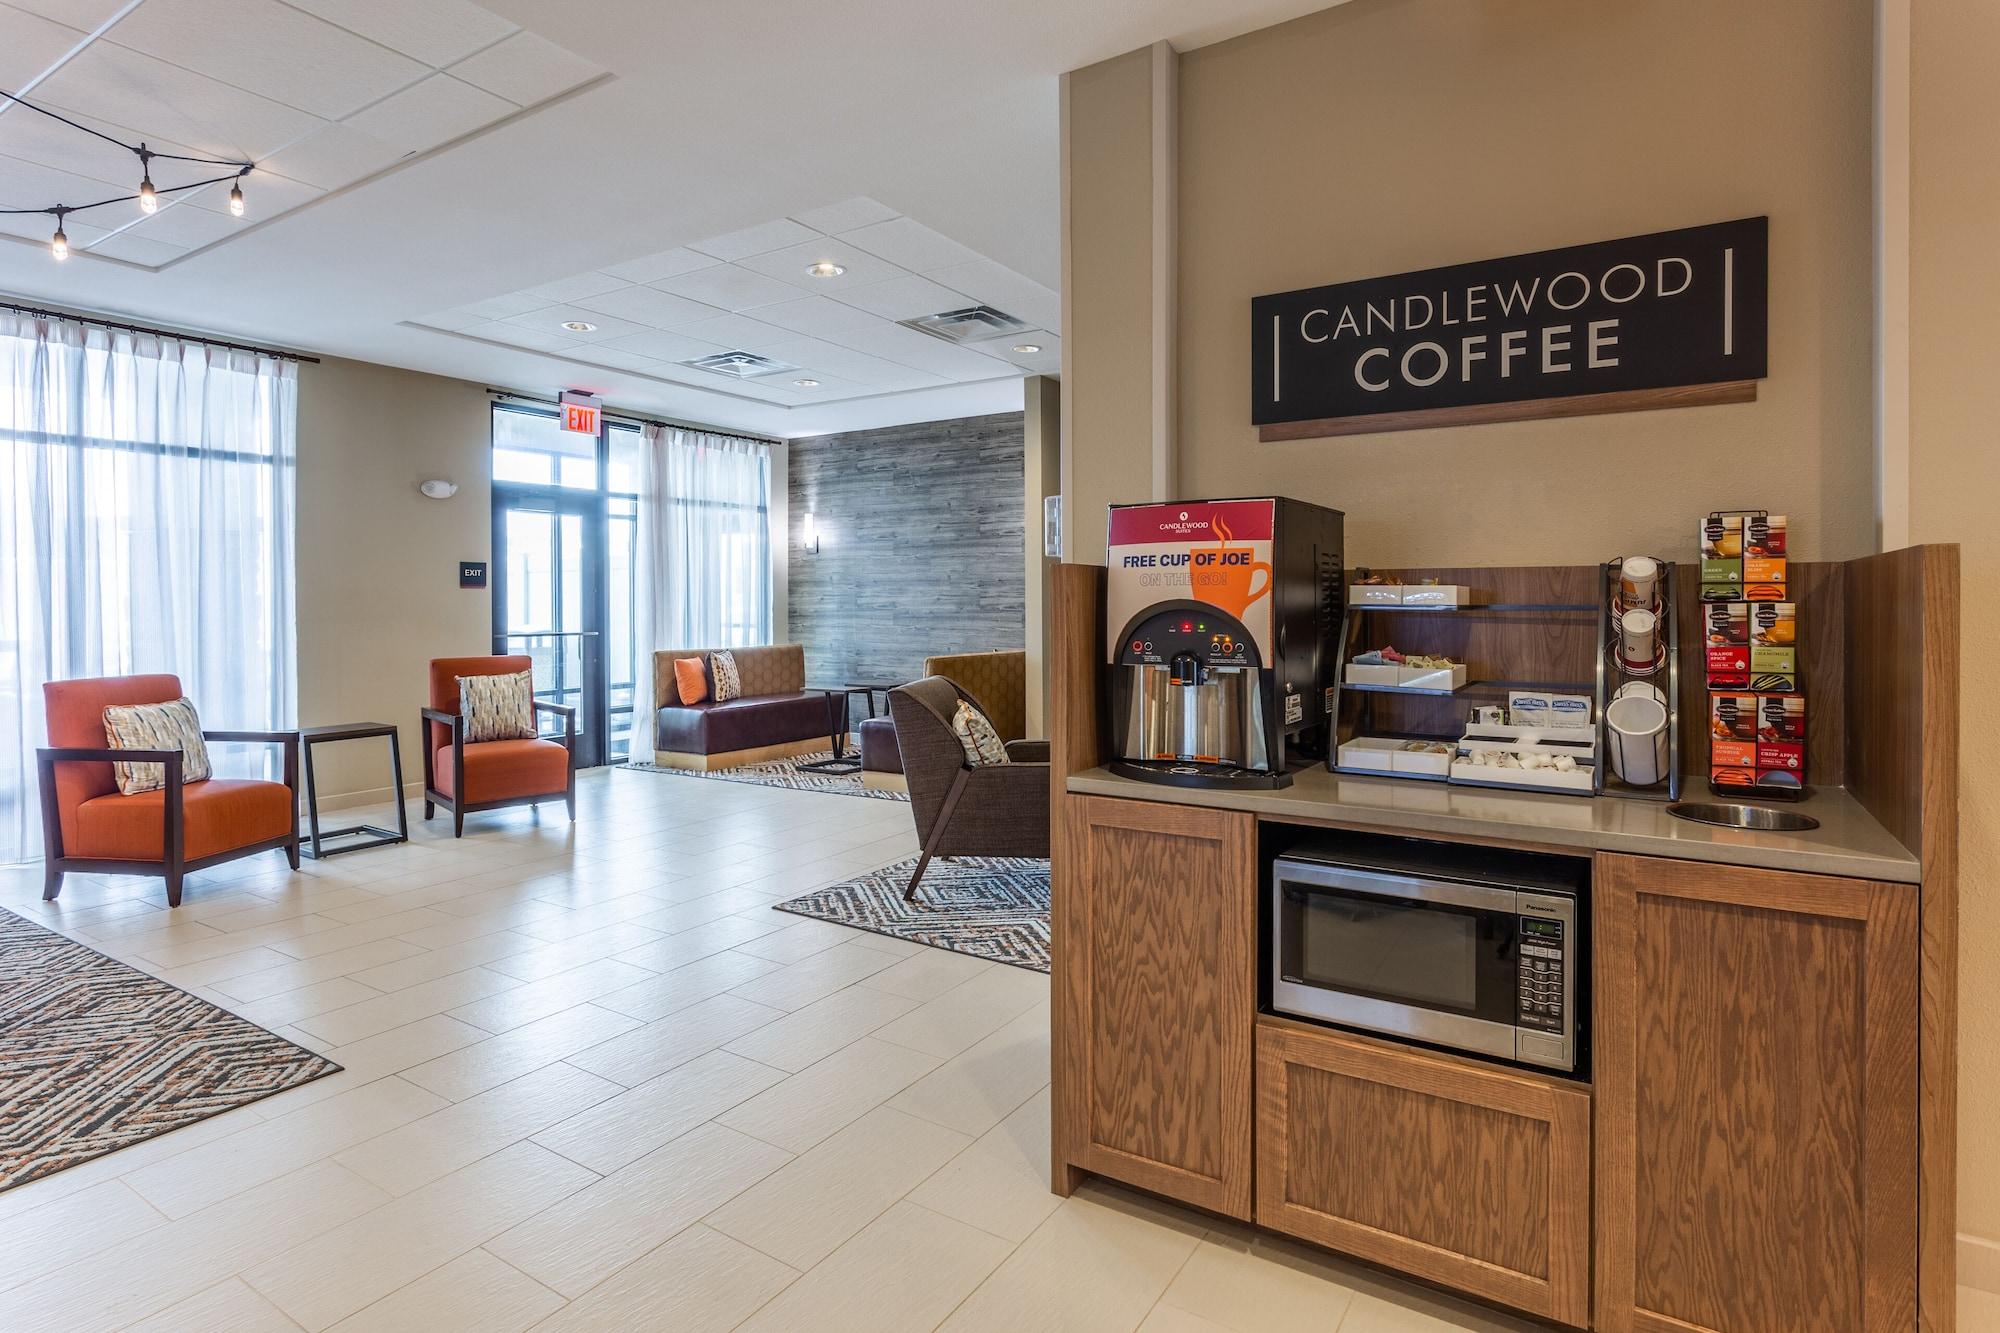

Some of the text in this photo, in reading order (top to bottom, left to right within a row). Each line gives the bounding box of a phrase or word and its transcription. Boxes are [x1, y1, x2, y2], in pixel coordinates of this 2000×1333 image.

[1301, 257, 1692, 343] CANDLEWOOD
[1354, 319, 1620, 392] COFFEE
[568, 407, 595, 432] EXIT
[1160, 521, 1209, 530] CANDLEWOOD
[1123, 552, 1250, 568] FREE CUP OF JOE
[464, 569, 482, 577] EXIT
[1139, 571, 1227, 586] ON THE GO!
[1526, 904, 1556, 912] Panasonic
